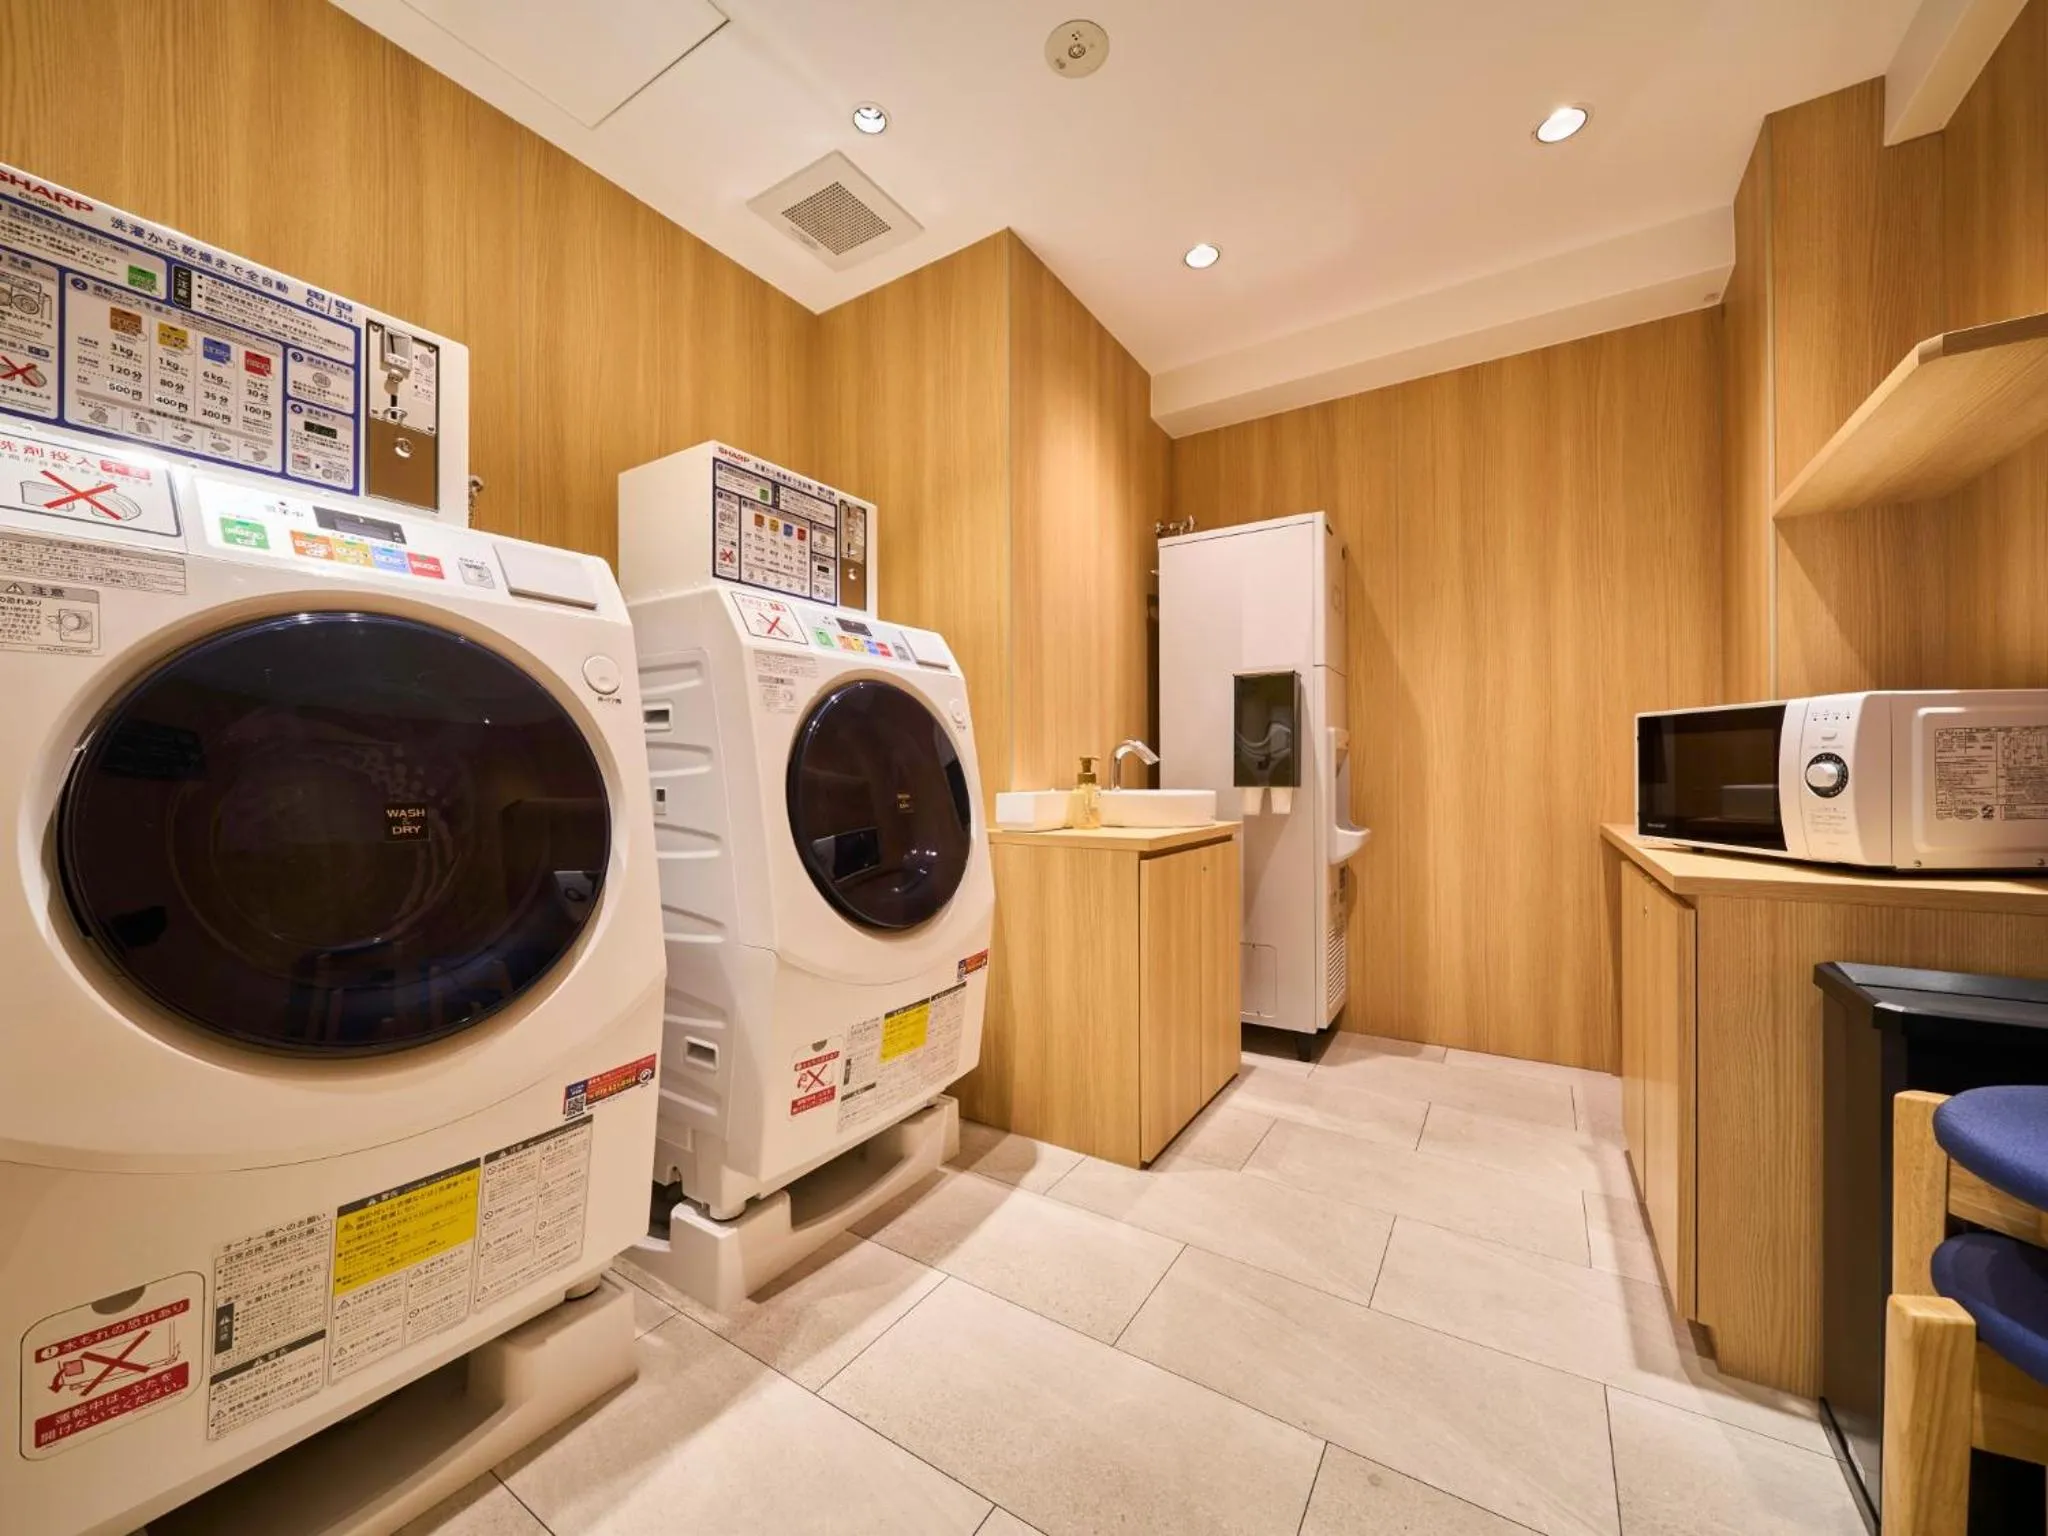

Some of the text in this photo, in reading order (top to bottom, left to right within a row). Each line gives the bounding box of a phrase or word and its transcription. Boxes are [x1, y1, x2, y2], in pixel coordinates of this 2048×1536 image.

[0, 170, 94, 212] SHARP
[110, 215, 290, 295] 洗濯から乾燥まで全自動
[108, 383, 143, 401] 500円
[156, 396, 188, 414] 400円
[386, 808, 425, 817] WASH
[392, 825, 421, 835] DRY
[62, 1302, 185, 1351] 水もれの恐れあり
[40, 1383, 183, 1443] 開けないでください。
[56, 1373, 174, 1425] 運転中は、ふたを
